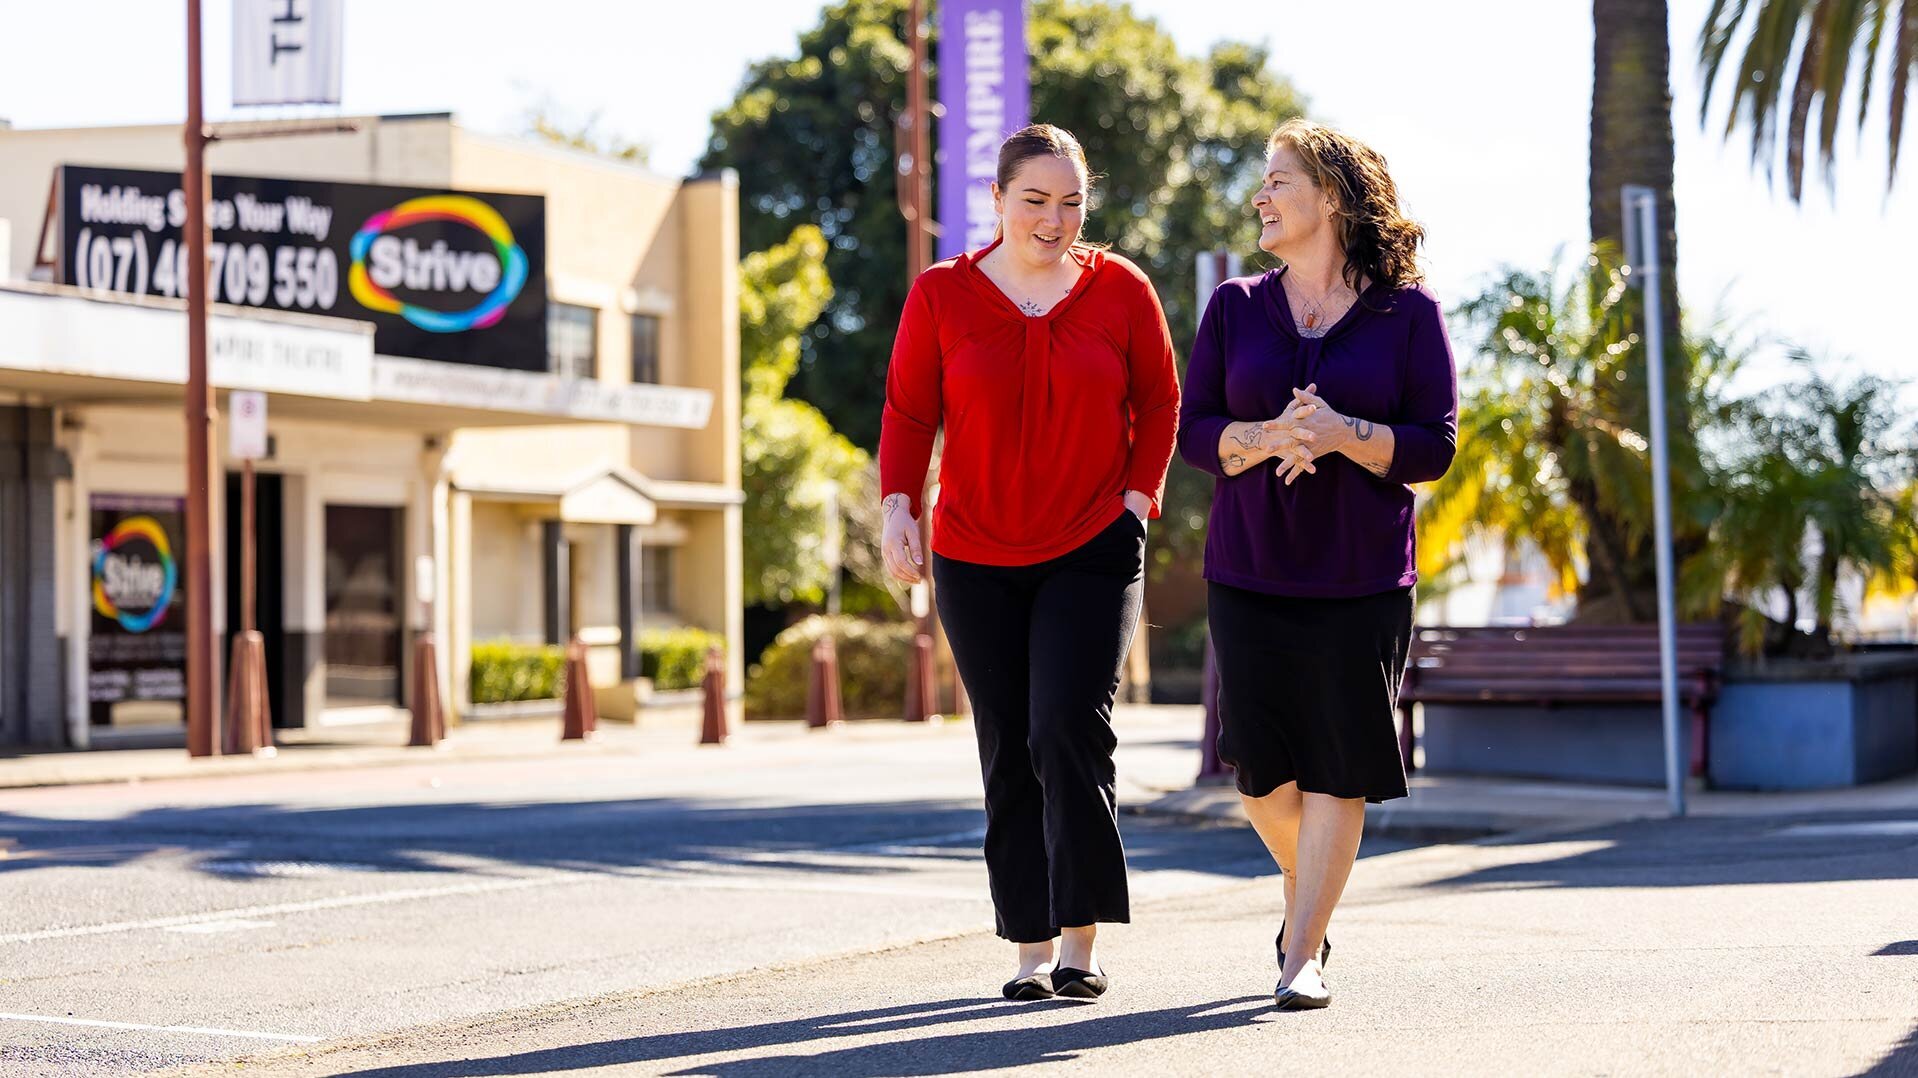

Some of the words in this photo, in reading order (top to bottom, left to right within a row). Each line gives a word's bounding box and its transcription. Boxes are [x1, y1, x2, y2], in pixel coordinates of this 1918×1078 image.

[80, 183, 166, 232] Holding
[167, 188, 235, 230] Sce
[234, 192, 284, 233] Your
[285, 195, 333, 242] Way
[76, 227, 149, 297] (07)
[204, 242, 270, 306] 709
[273, 245, 338, 309] 550
[368, 234, 500, 293] Strive
[104, 552, 165, 597] Strive
